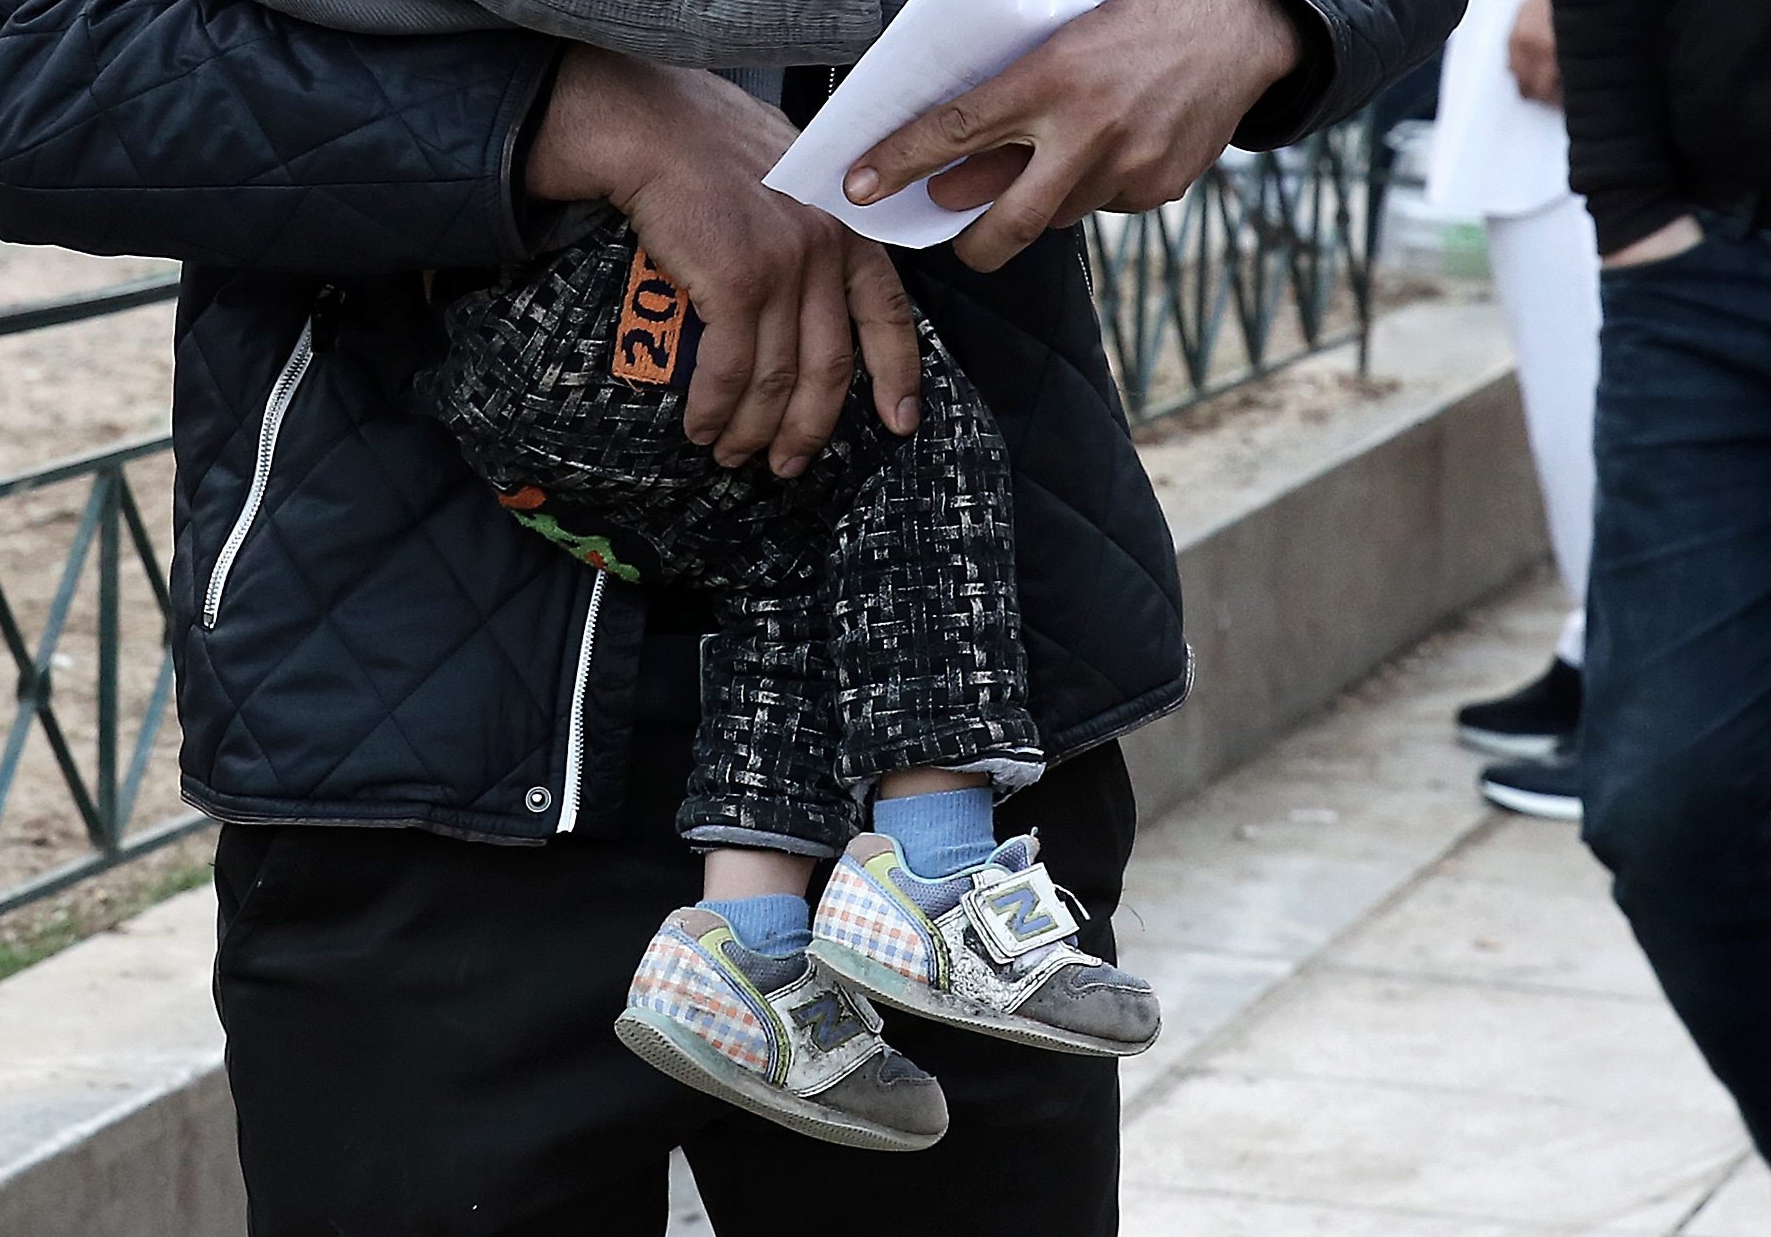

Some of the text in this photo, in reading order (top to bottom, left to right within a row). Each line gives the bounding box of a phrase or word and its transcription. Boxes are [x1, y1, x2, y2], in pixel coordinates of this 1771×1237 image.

[621, 254, 679, 368] 20
[985, 879, 1061, 942] N
[789, 991, 868, 1053] N
